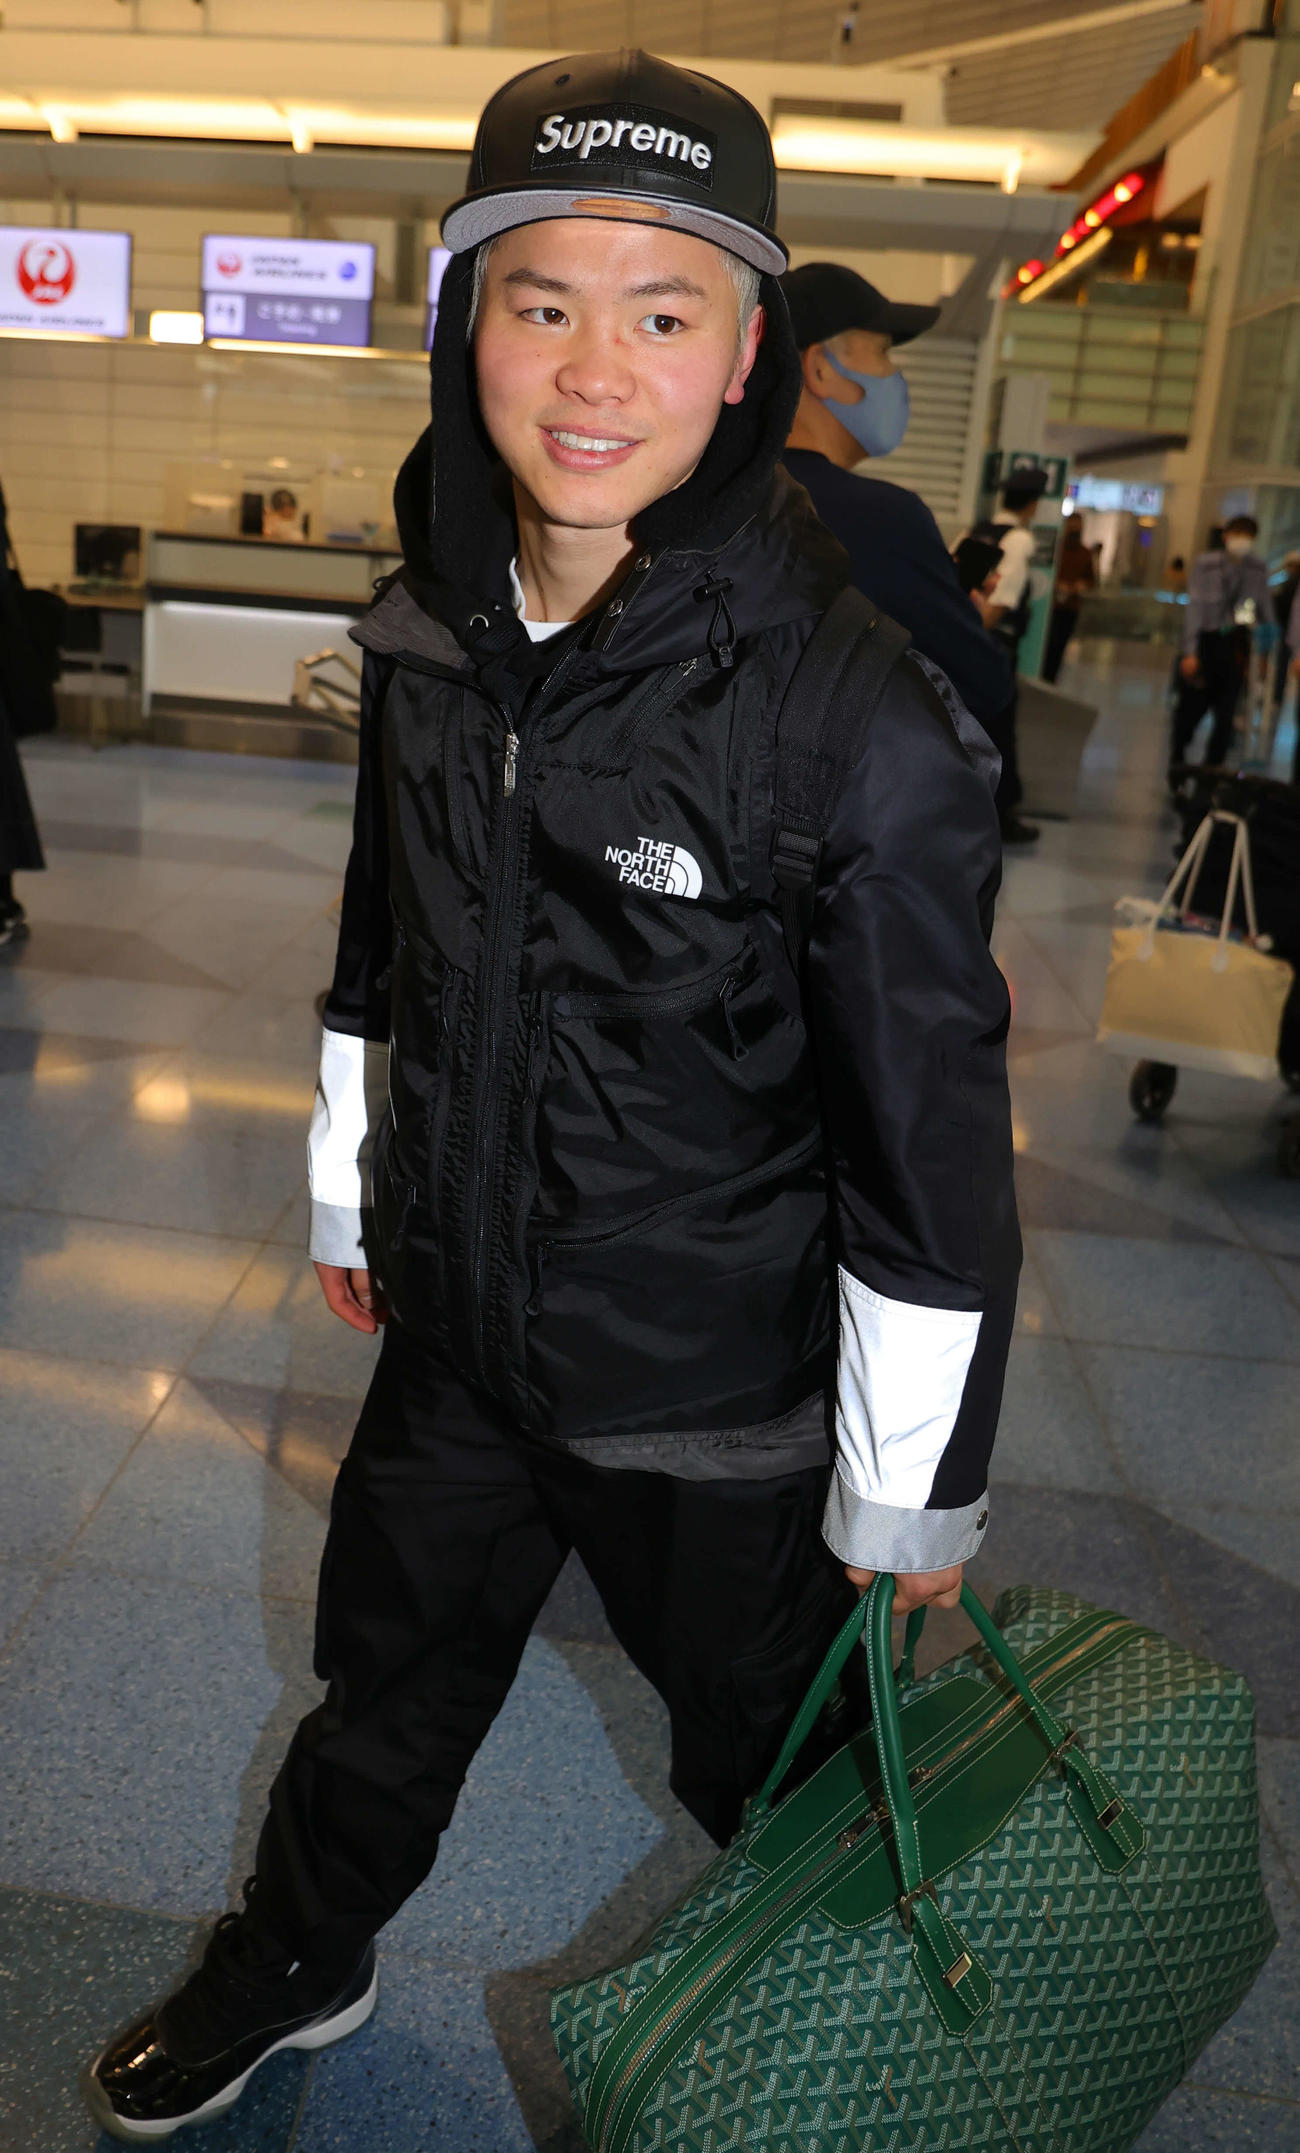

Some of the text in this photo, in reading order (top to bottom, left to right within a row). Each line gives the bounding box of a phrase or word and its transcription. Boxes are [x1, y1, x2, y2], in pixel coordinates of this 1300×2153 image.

[535, 114, 712, 170] Supreme
[604, 845, 671, 877] NORTH
[637, 836, 675, 860] THE
[618, 866, 667, 893] FACE
